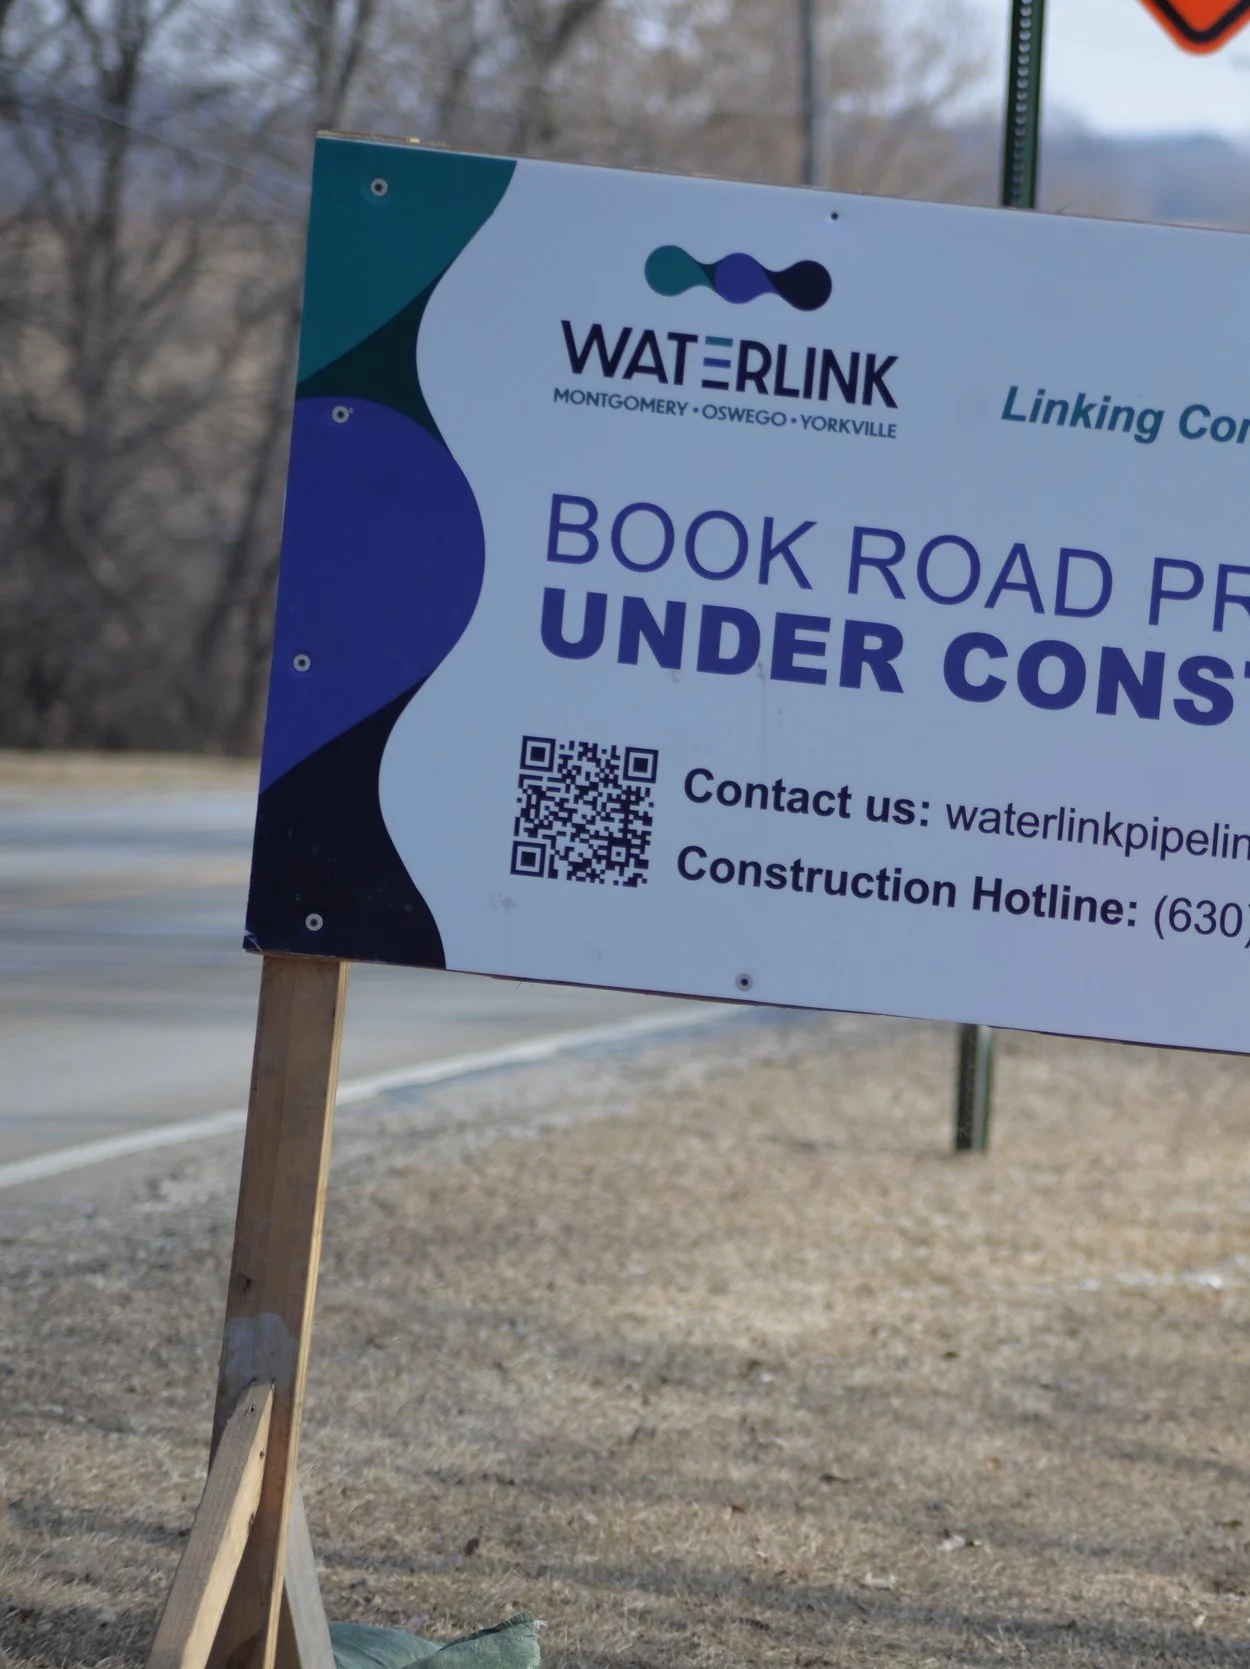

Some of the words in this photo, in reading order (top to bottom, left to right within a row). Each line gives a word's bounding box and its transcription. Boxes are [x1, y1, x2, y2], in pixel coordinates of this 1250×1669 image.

[560, 319, 899, 409] WATERLINK
[552, 386, 689, 418] MONTGOMERY
[701, 403, 788, 428] OSWEGO
[799, 414, 898, 439] YORKVILLE
[1000, 385, 1164, 445] Linking
[546, 493, 818, 590] BOOK
[847, 525, 1114, 619] ROAD
[540, 586, 905, 694] UNDER
[683, 767, 852, 819] Contact
[865, 795, 930, 827] us:
[676, 845, 957, 908] Construction
[972, 875, 1137, 928] Hotline:
